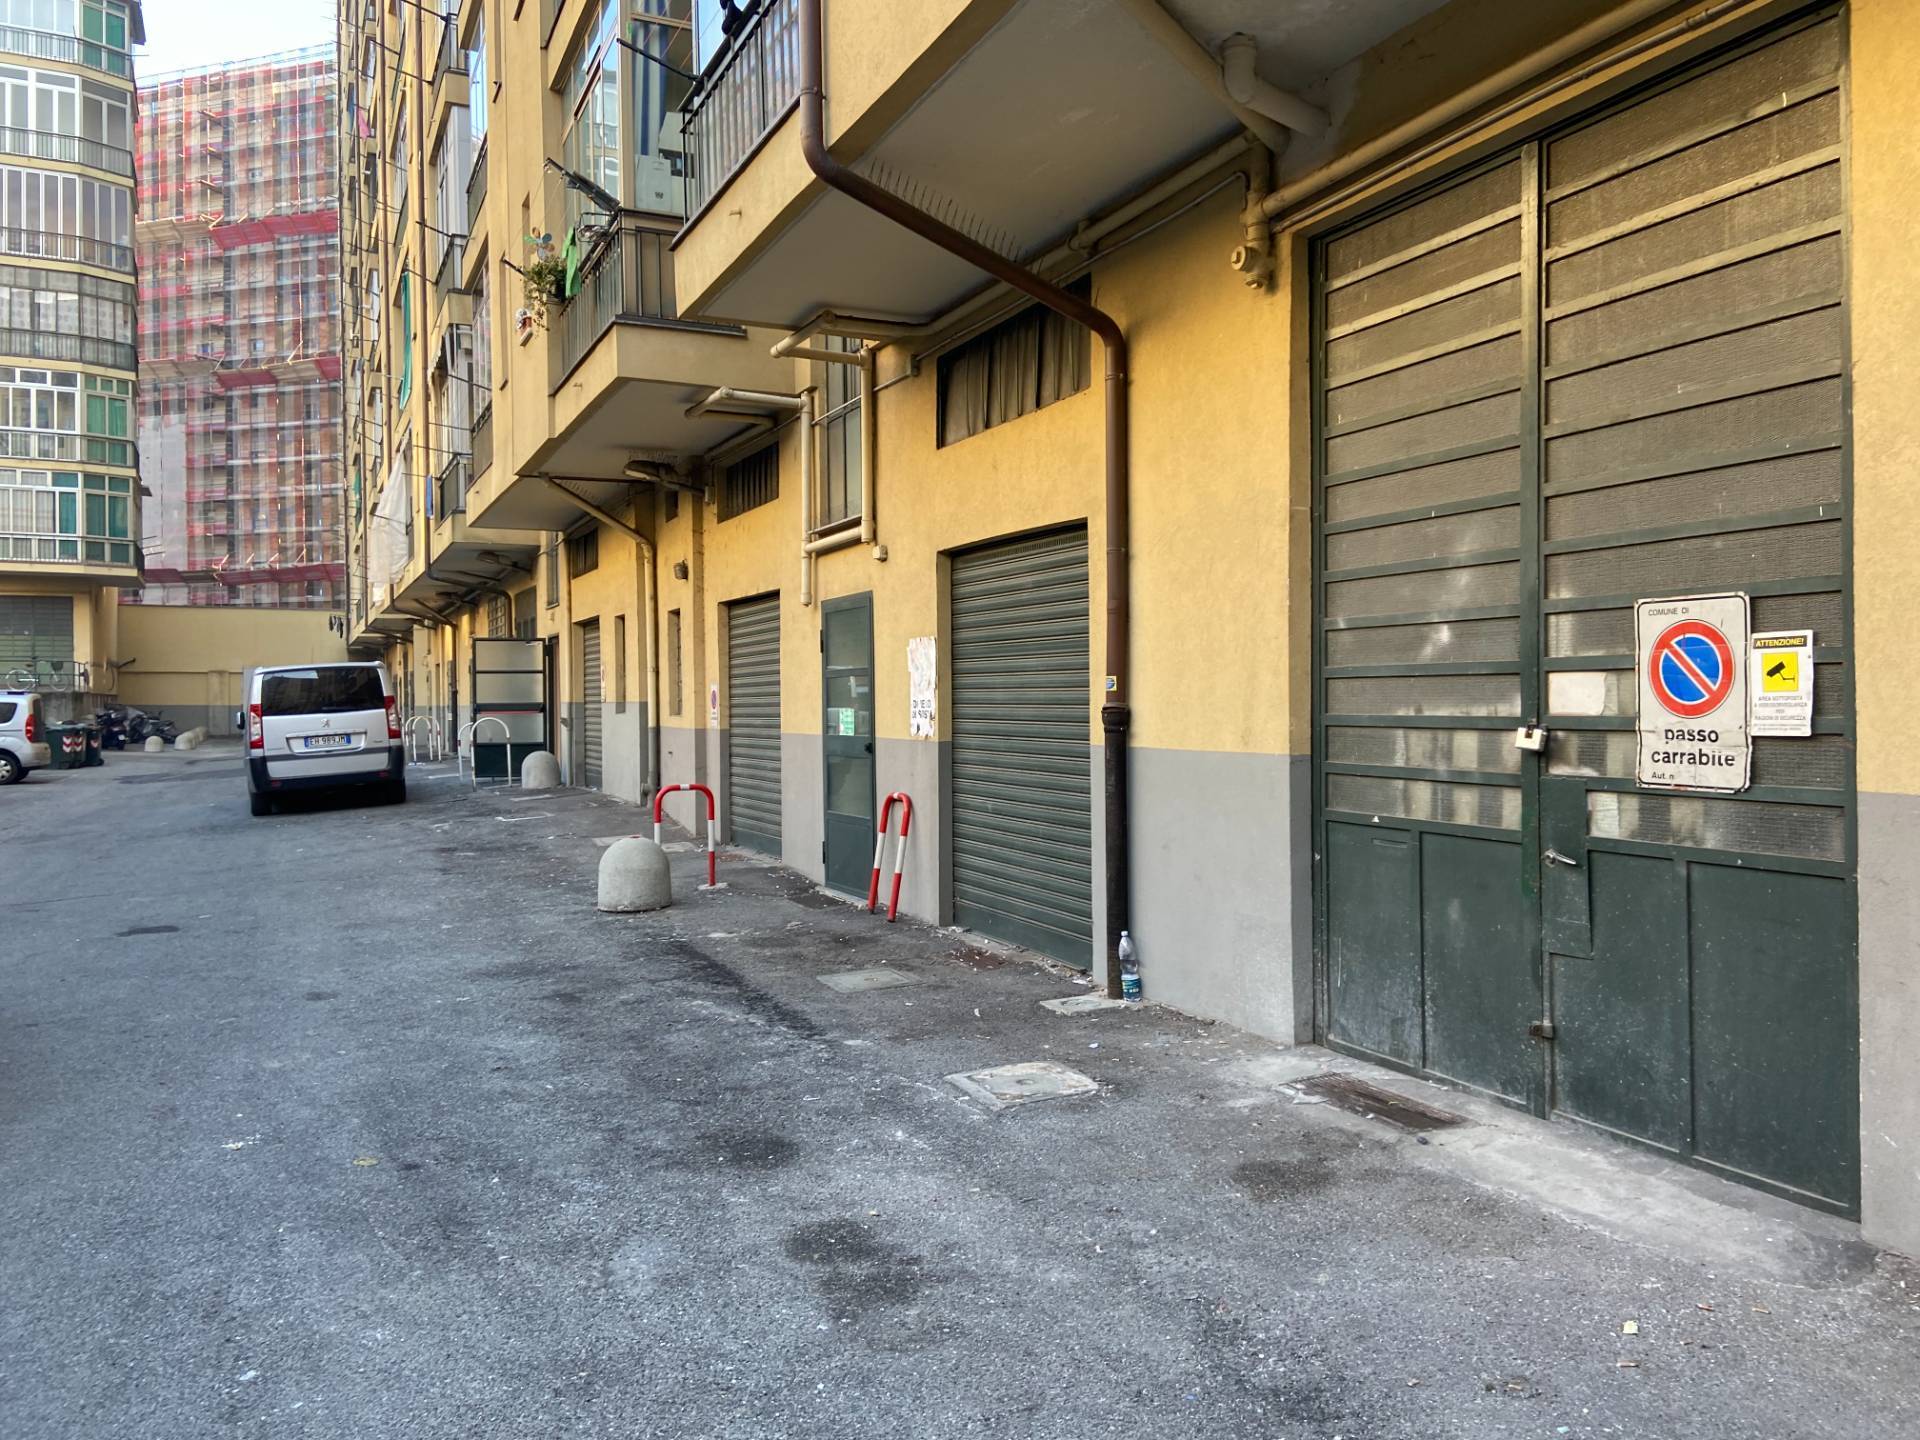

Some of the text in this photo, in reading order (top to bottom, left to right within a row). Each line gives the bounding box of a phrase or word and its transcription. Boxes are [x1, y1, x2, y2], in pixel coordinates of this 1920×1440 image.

[1648, 608, 1678, 616] COMUNE
[1755, 638, 1804, 646] ATTENZIONE!
[1664, 728, 1719, 745] passo
[1651, 748, 1736, 767] carrabile
